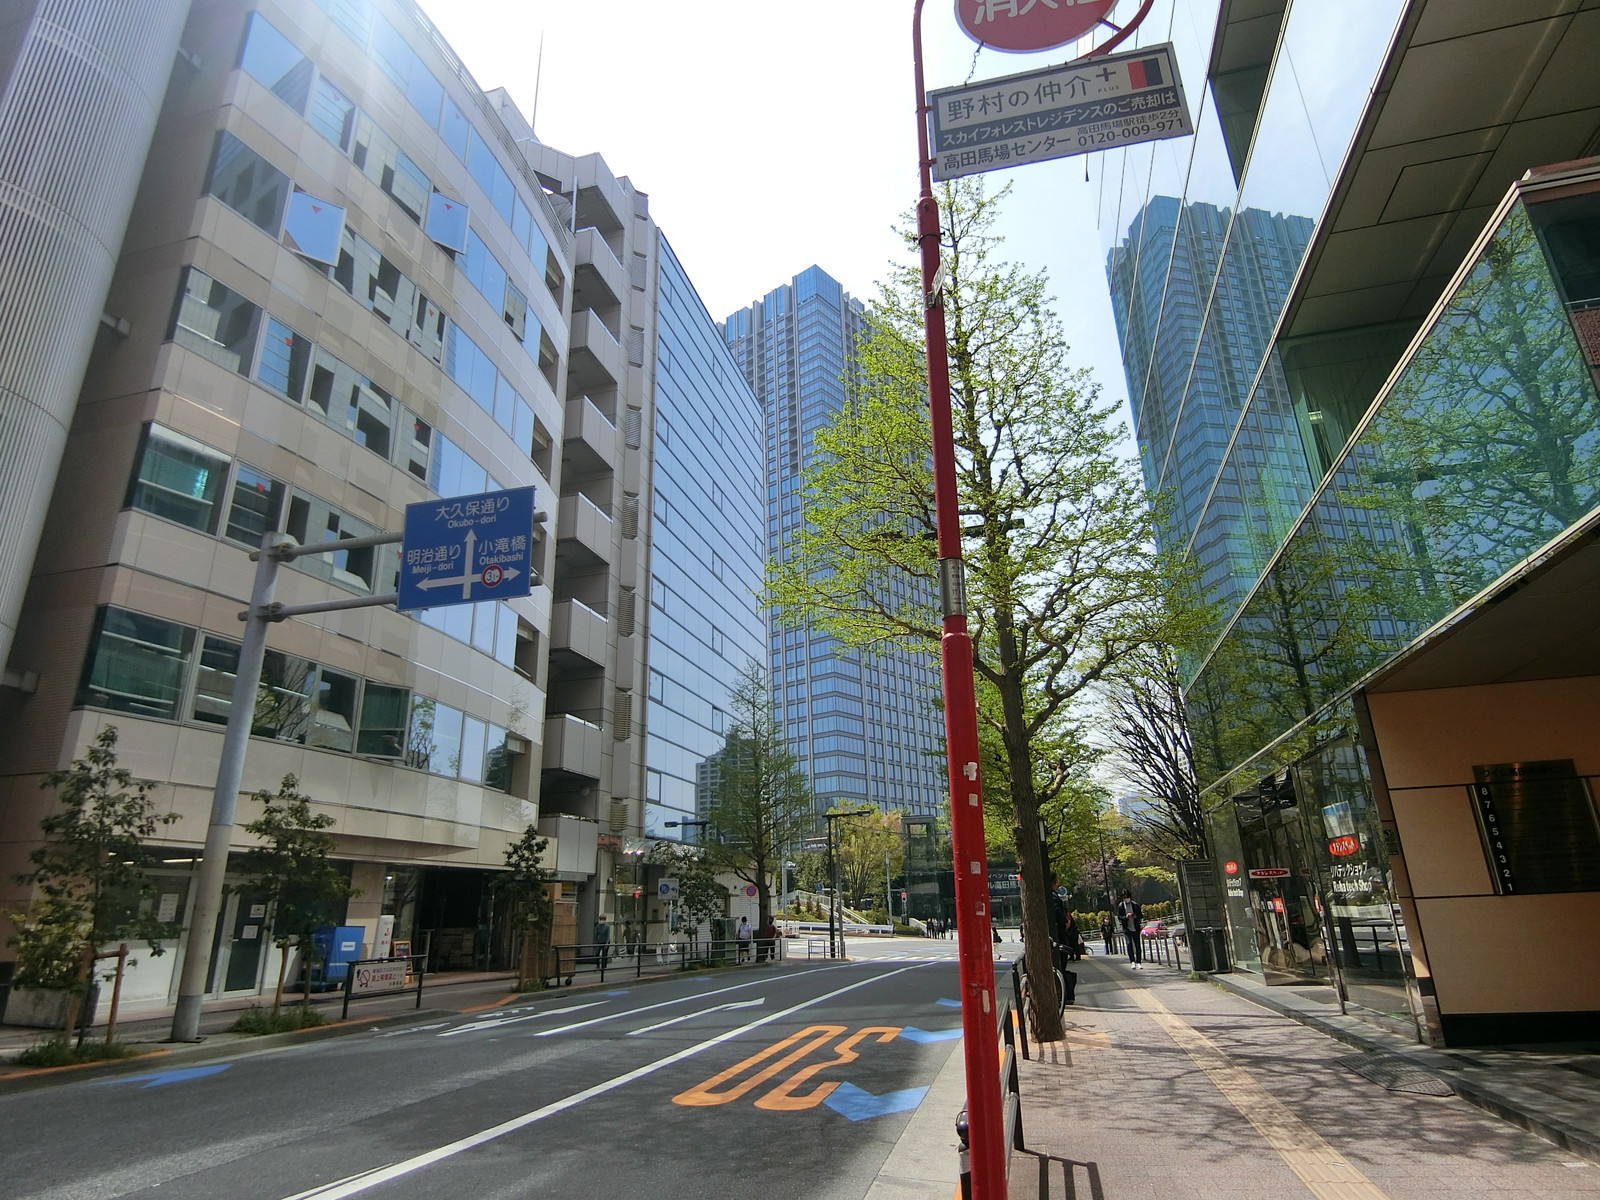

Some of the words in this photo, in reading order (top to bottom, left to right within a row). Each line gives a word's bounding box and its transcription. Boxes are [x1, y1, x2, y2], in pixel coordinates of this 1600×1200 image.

[1097, 85, 1120, 94] PLUS
[943, 91, 1177, 147] スカイフォレストレジデンスのご売却は
[1077, 110, 1180, 135] 高田馬場駅徒歩2分
[1078, 118, 1184, 147] 0120-009-971
[943, 136, 1071, 171] 高田馬場センター
[435, 496, 510, 521] 大久保通り
[407, 544, 461, 566] 明治通り
[478, 535, 527, 556] 小滝橋
[479, 552, 524, 566] Otakibashi
[1488, 814, 1495, 822] 6
[1500, 855, 1506, 863] 3
[1503, 869, 1511, 877] 2
[1507, 883, 1513, 891] 1
